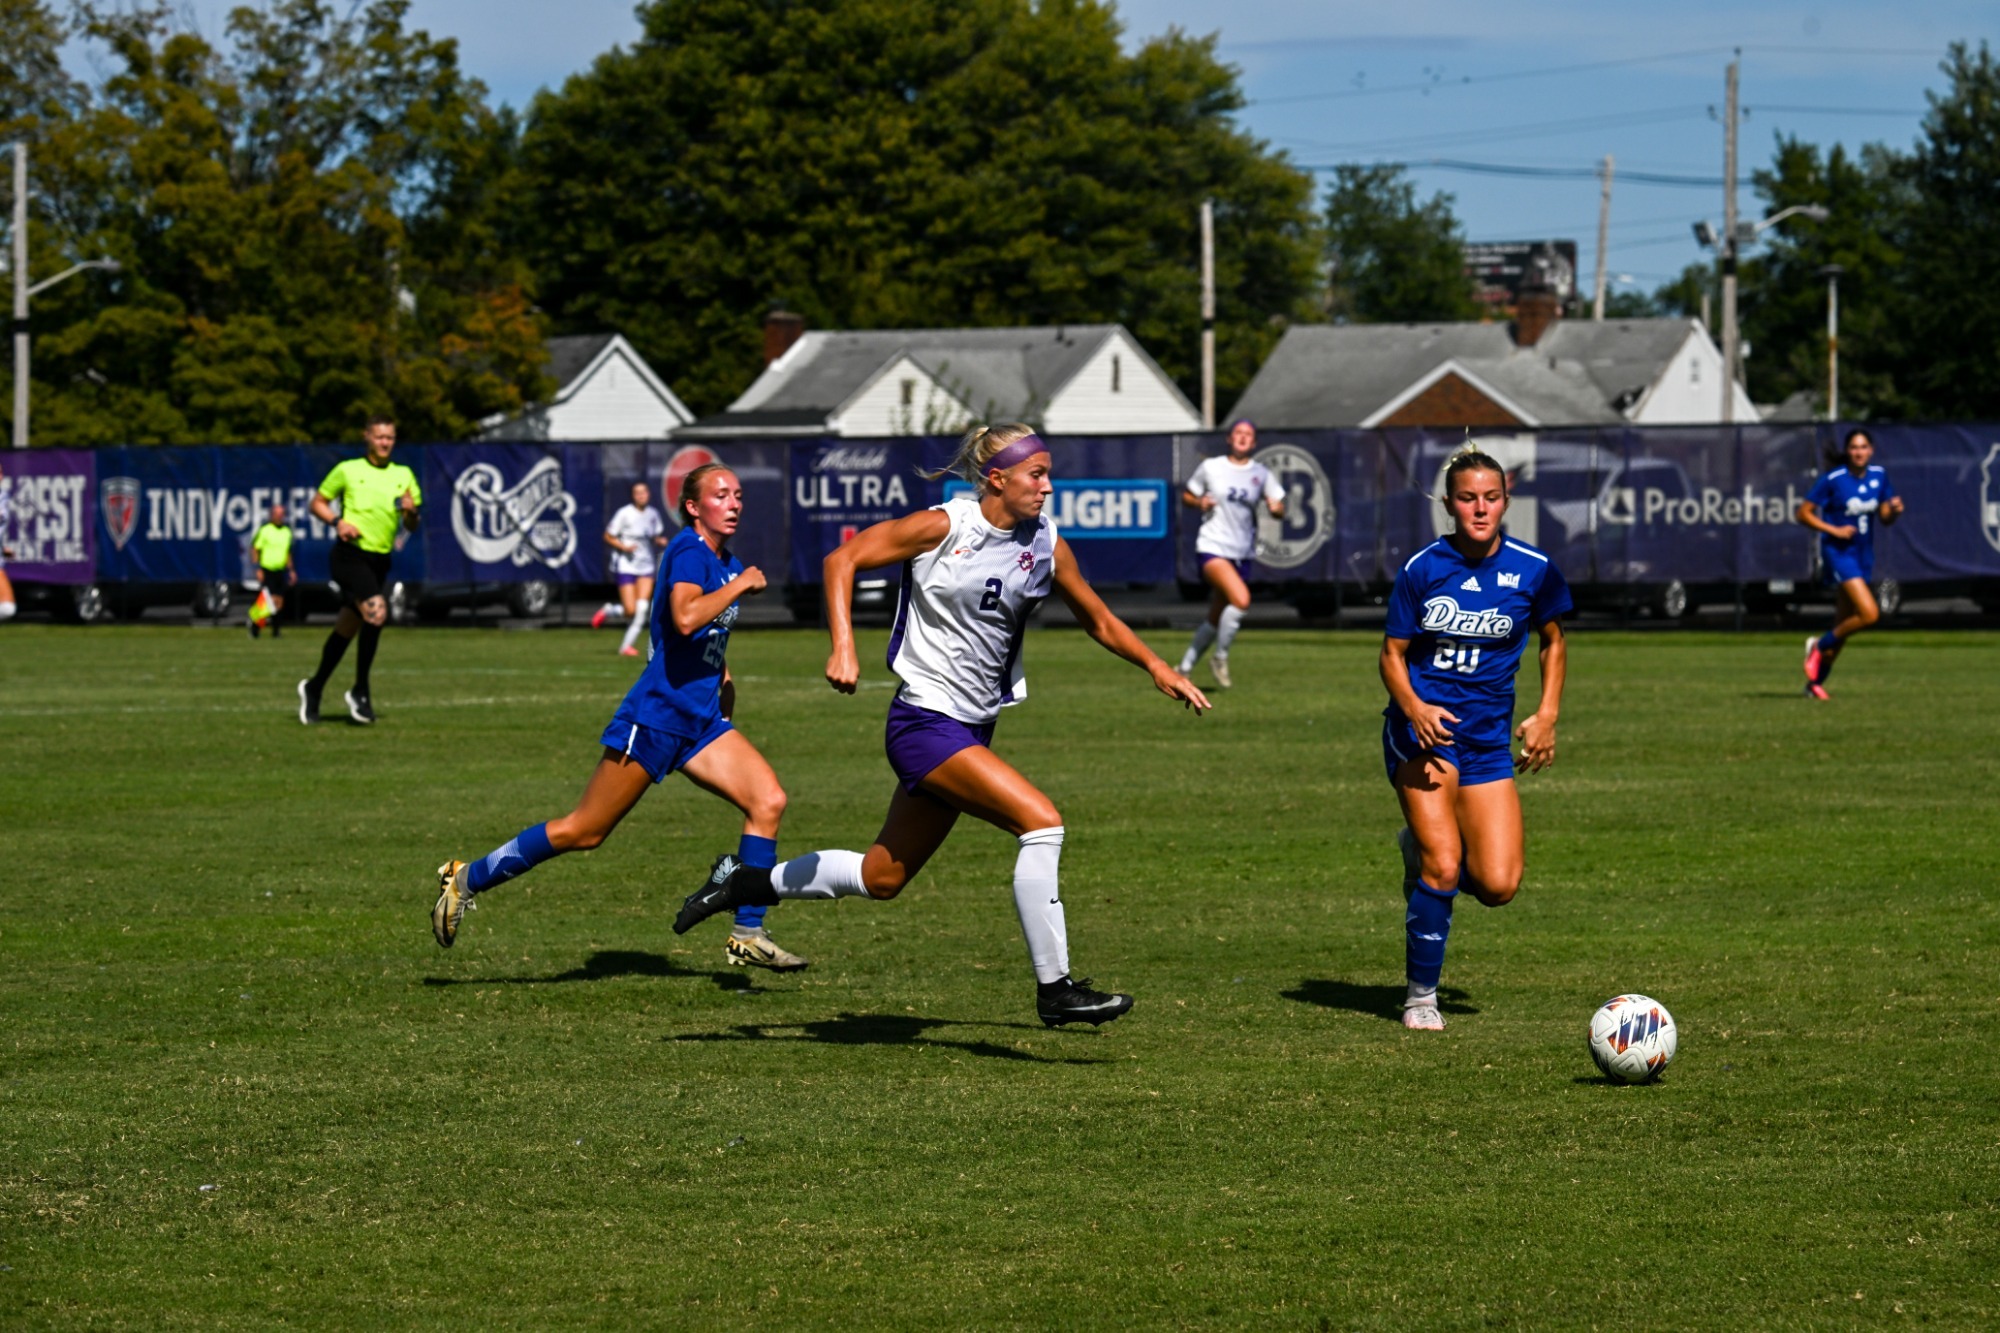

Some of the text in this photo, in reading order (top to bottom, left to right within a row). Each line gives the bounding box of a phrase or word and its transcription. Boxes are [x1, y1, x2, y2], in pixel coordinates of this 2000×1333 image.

[796, 475, 908, 508] ULTRA
[146, 488, 228, 539] INDY
[979, 577, 1003, 611] 2
[1421, 595, 1513, 638] Drake
[1433, 638, 1480, 674] 20
